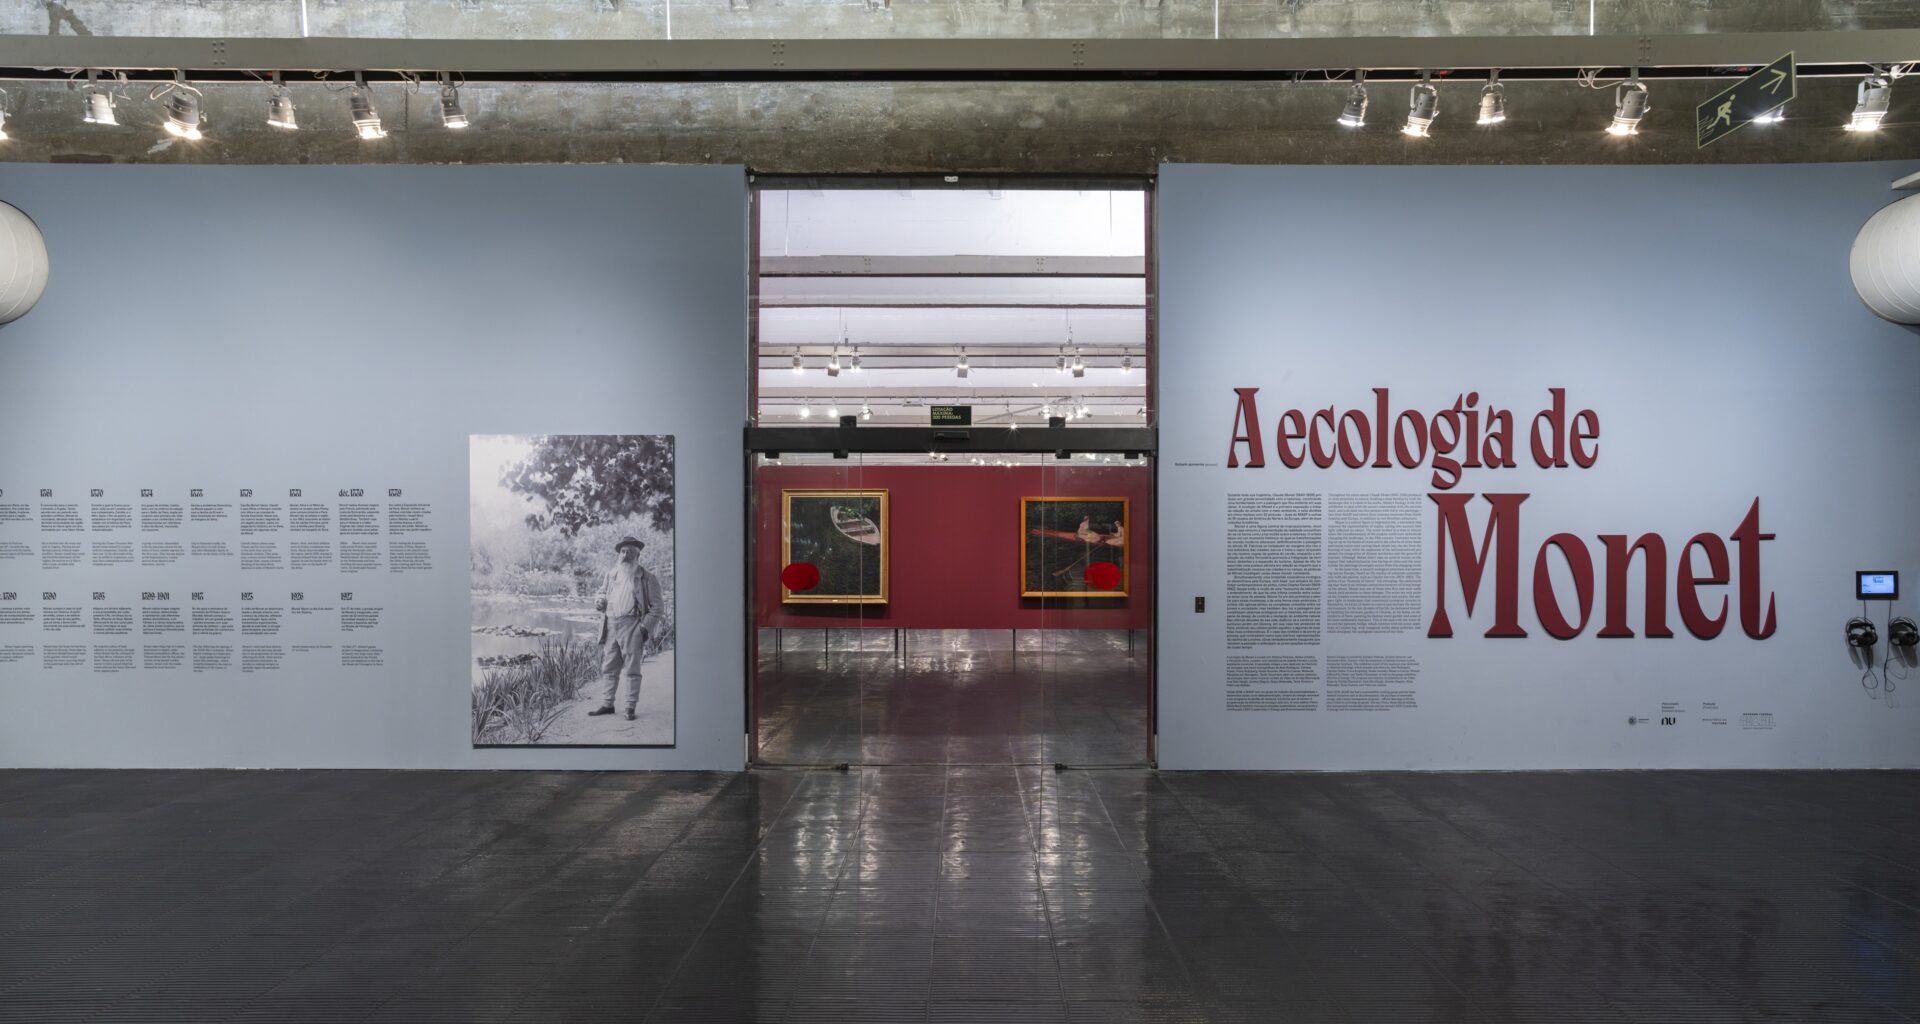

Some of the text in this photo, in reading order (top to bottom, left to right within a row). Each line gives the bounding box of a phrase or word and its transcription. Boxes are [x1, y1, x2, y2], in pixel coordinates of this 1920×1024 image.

[1227, 387, 1600, 490] A ecologia de
[1427, 492, 1777, 641] Monet
